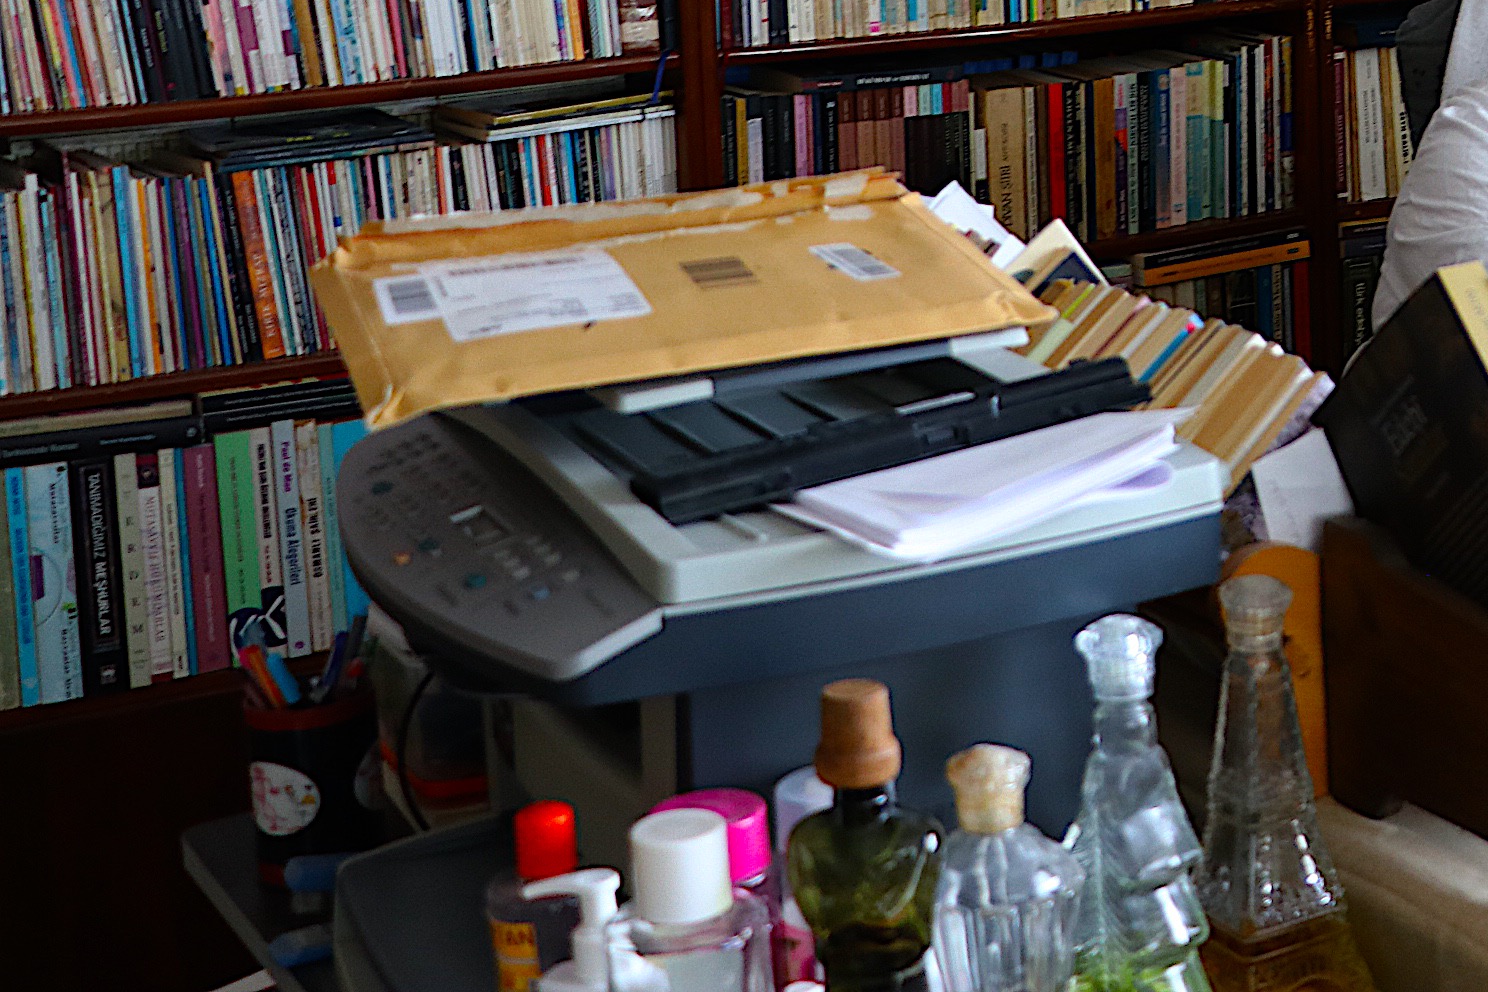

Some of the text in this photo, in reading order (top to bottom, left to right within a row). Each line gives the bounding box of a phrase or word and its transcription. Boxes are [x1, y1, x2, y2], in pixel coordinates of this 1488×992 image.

[280, 442, 292, 492] Paul de Man
[87, 472, 110, 635] TANIMADIĞIMIZ MEŞHURLAR
[284, 508, 300, 585] Okuma Alegorileri
